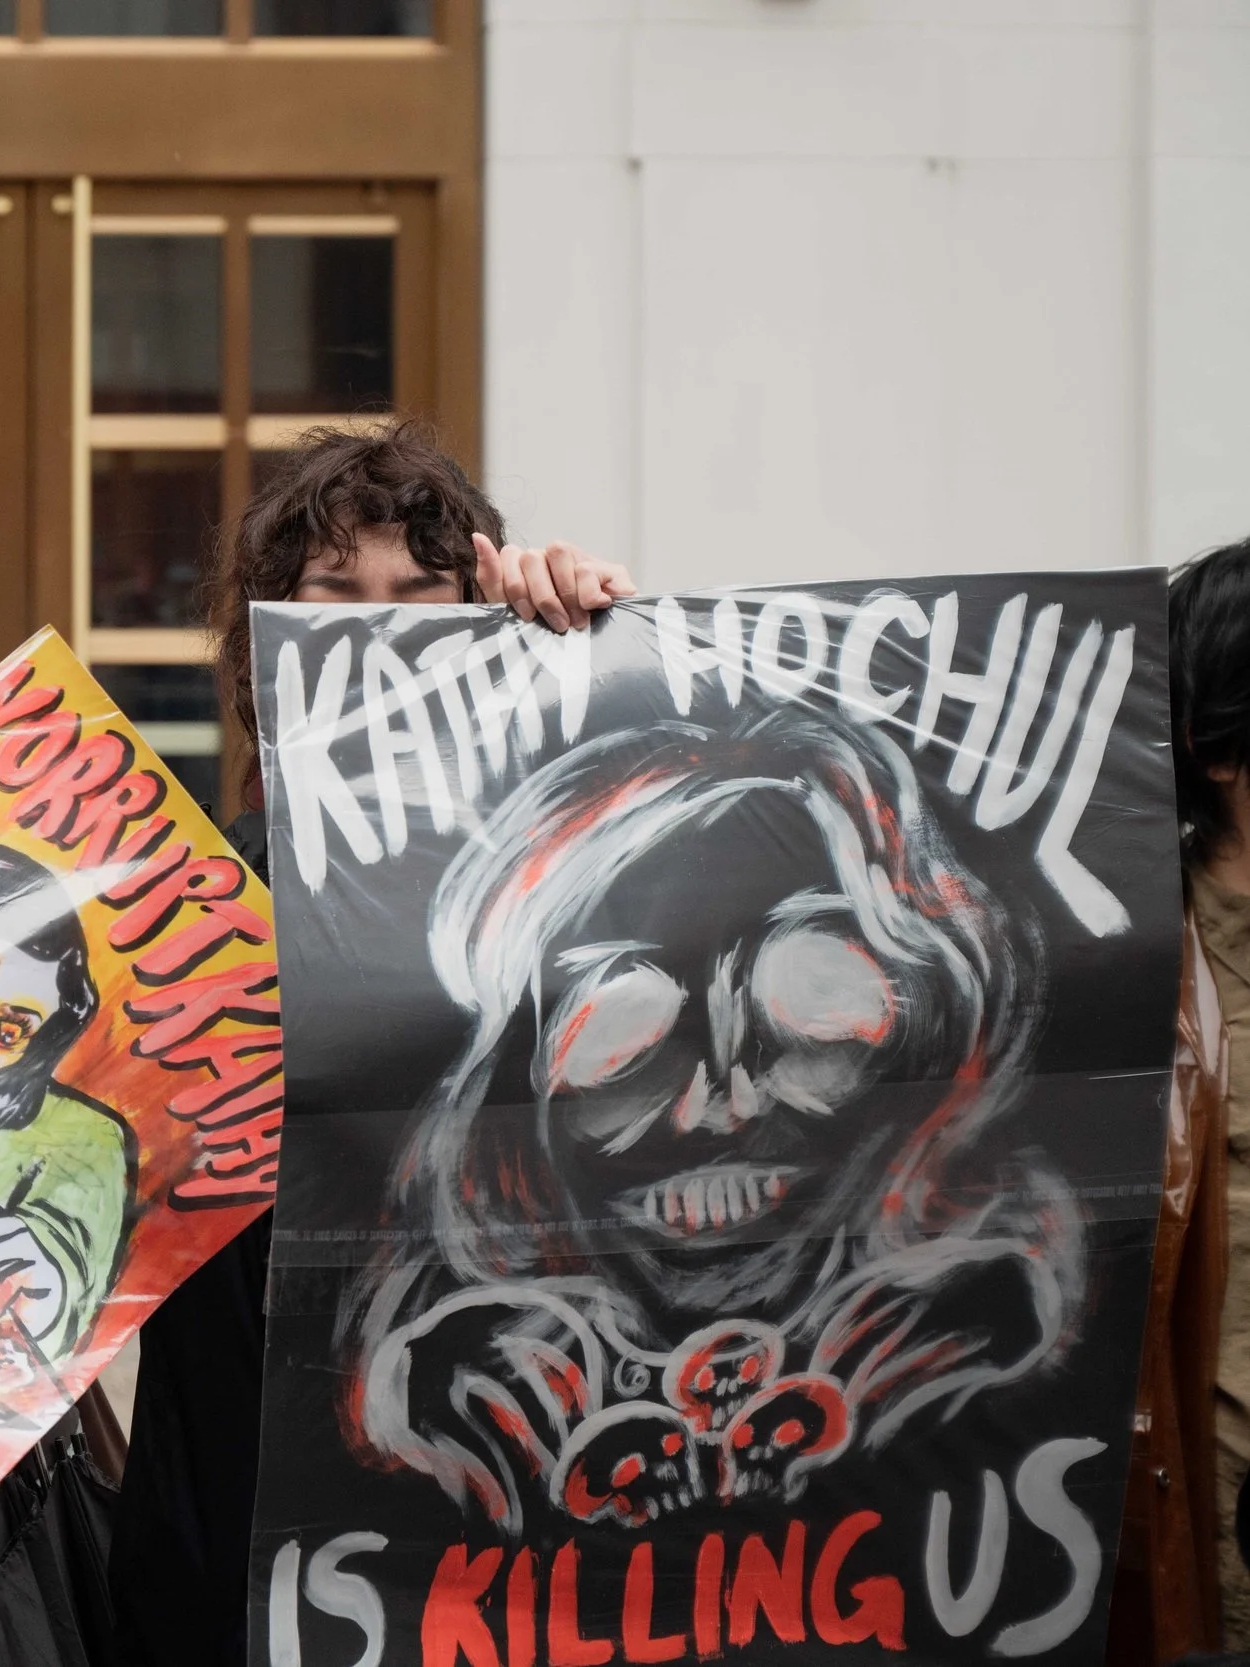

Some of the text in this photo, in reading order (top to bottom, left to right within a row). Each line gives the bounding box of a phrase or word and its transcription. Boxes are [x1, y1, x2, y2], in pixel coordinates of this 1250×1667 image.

[275, 587, 1136, 937] KATHY HOCHUL
[267, 1437, 1110, 1667] IS KILLING US
